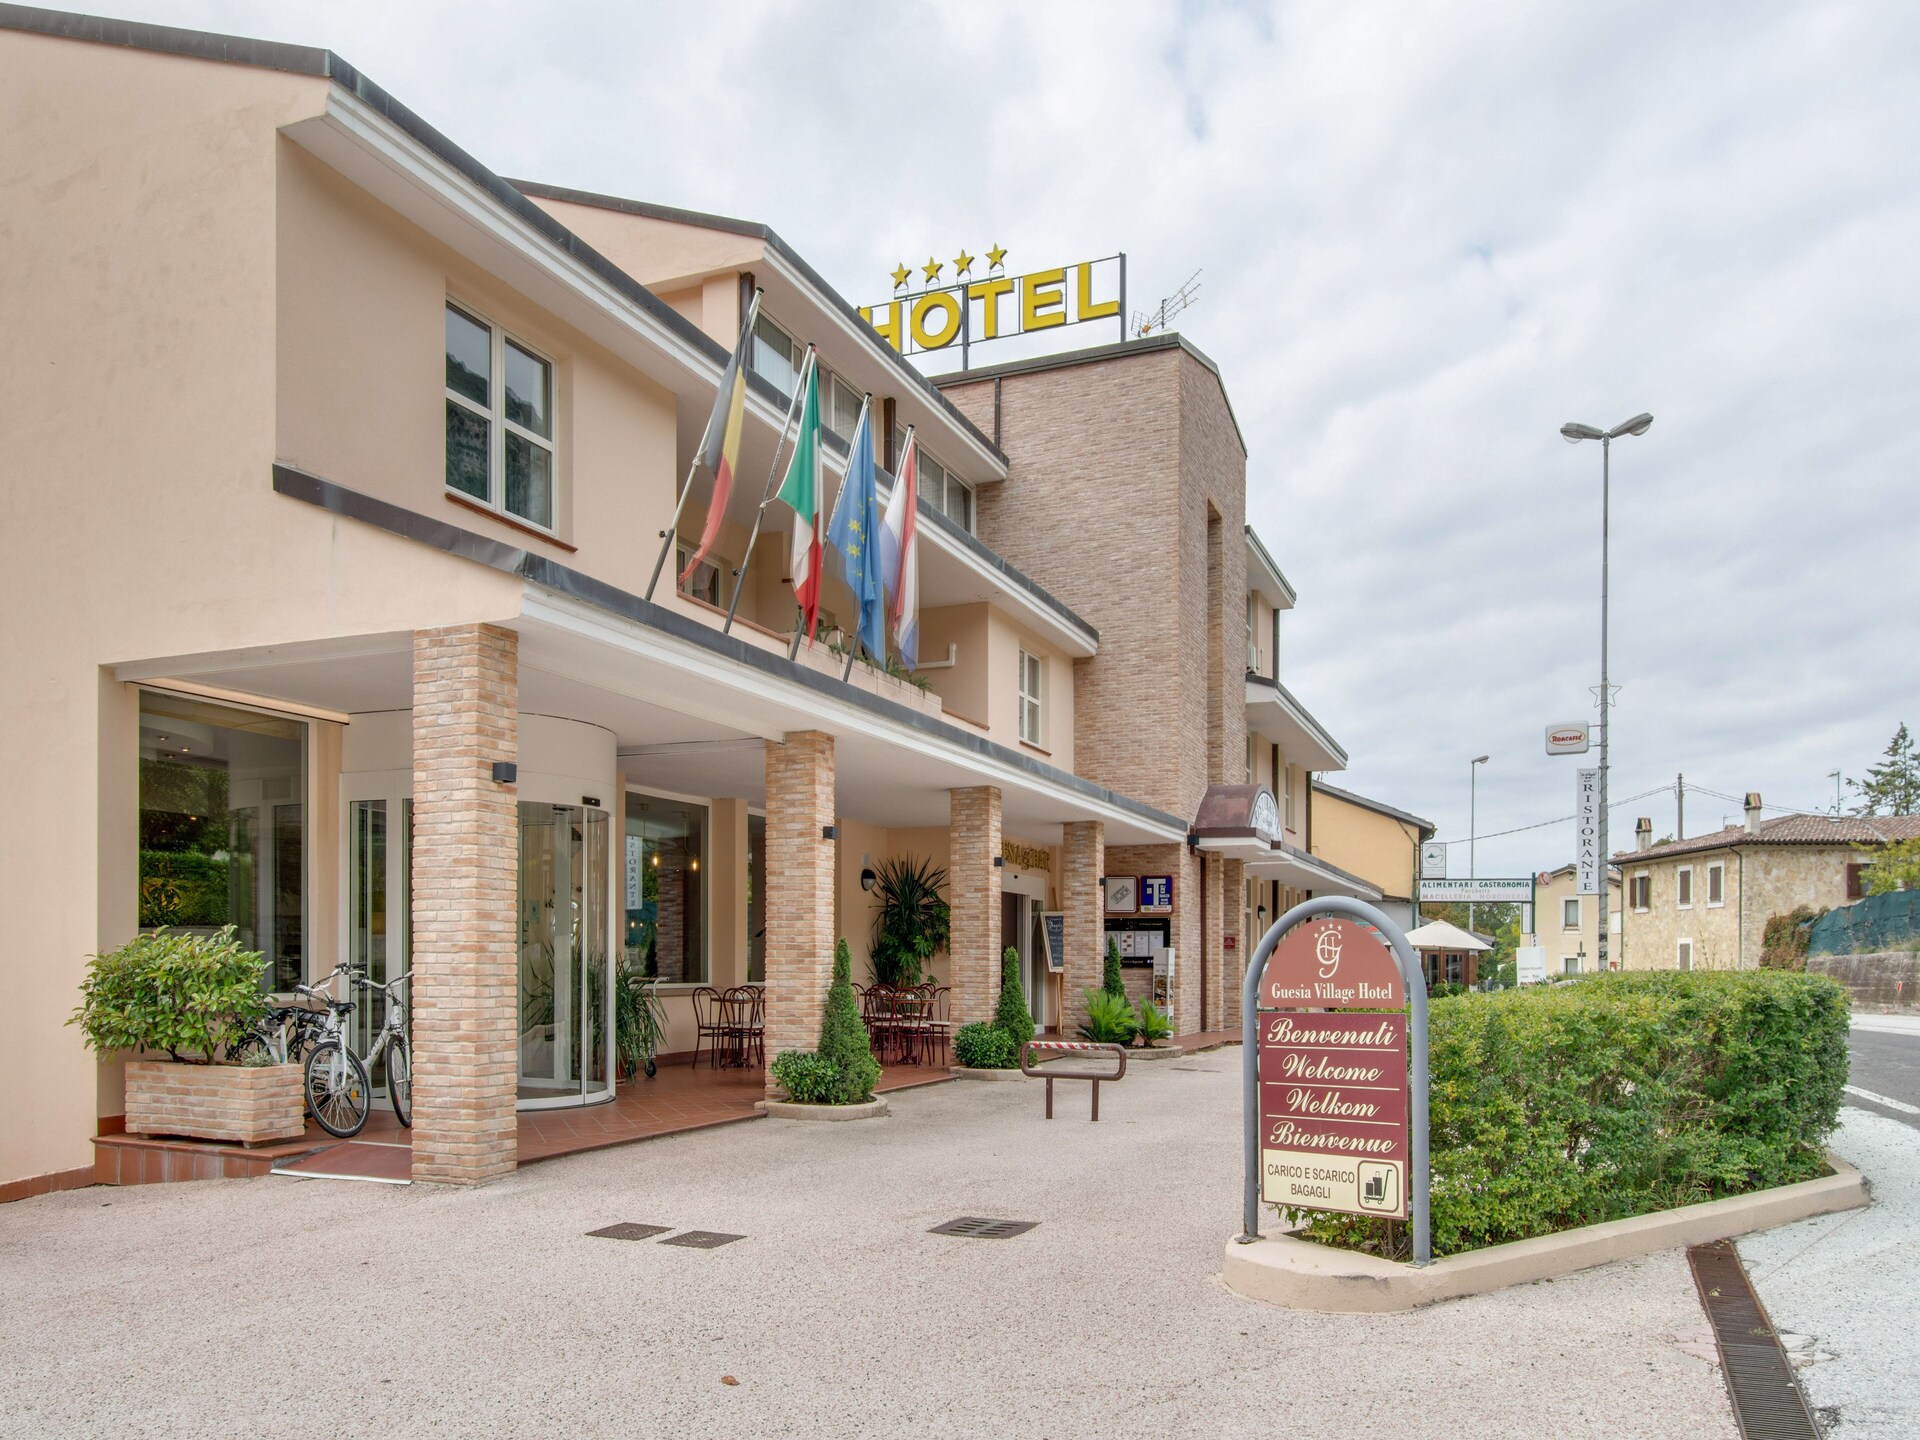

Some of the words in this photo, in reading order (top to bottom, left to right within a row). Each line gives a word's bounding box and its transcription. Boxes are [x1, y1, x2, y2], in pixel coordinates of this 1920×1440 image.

[859, 261, 1121, 354] HOTEL
[1581, 783, 1595, 891] RISTORANTE
[1271, 982, 1311, 999] Guesia
[1314, 982, 1355, 1003] Village
[1358, 982, 1392, 999] Hotel
[1267, 1017, 1398, 1046] Benvenuti
[1282, 1053, 1384, 1081] Welcome
[1286, 1088, 1381, 1117] Welkom
[1270, 1121, 1398, 1153] Bienvenue
[1267, 1163, 1303, 1179] CARICO
[1304, 1167, 1310, 1179] E
[1312, 1168, 1355, 1184] SCARICO
[1290, 1183, 1331, 1199] BAGAGLI
